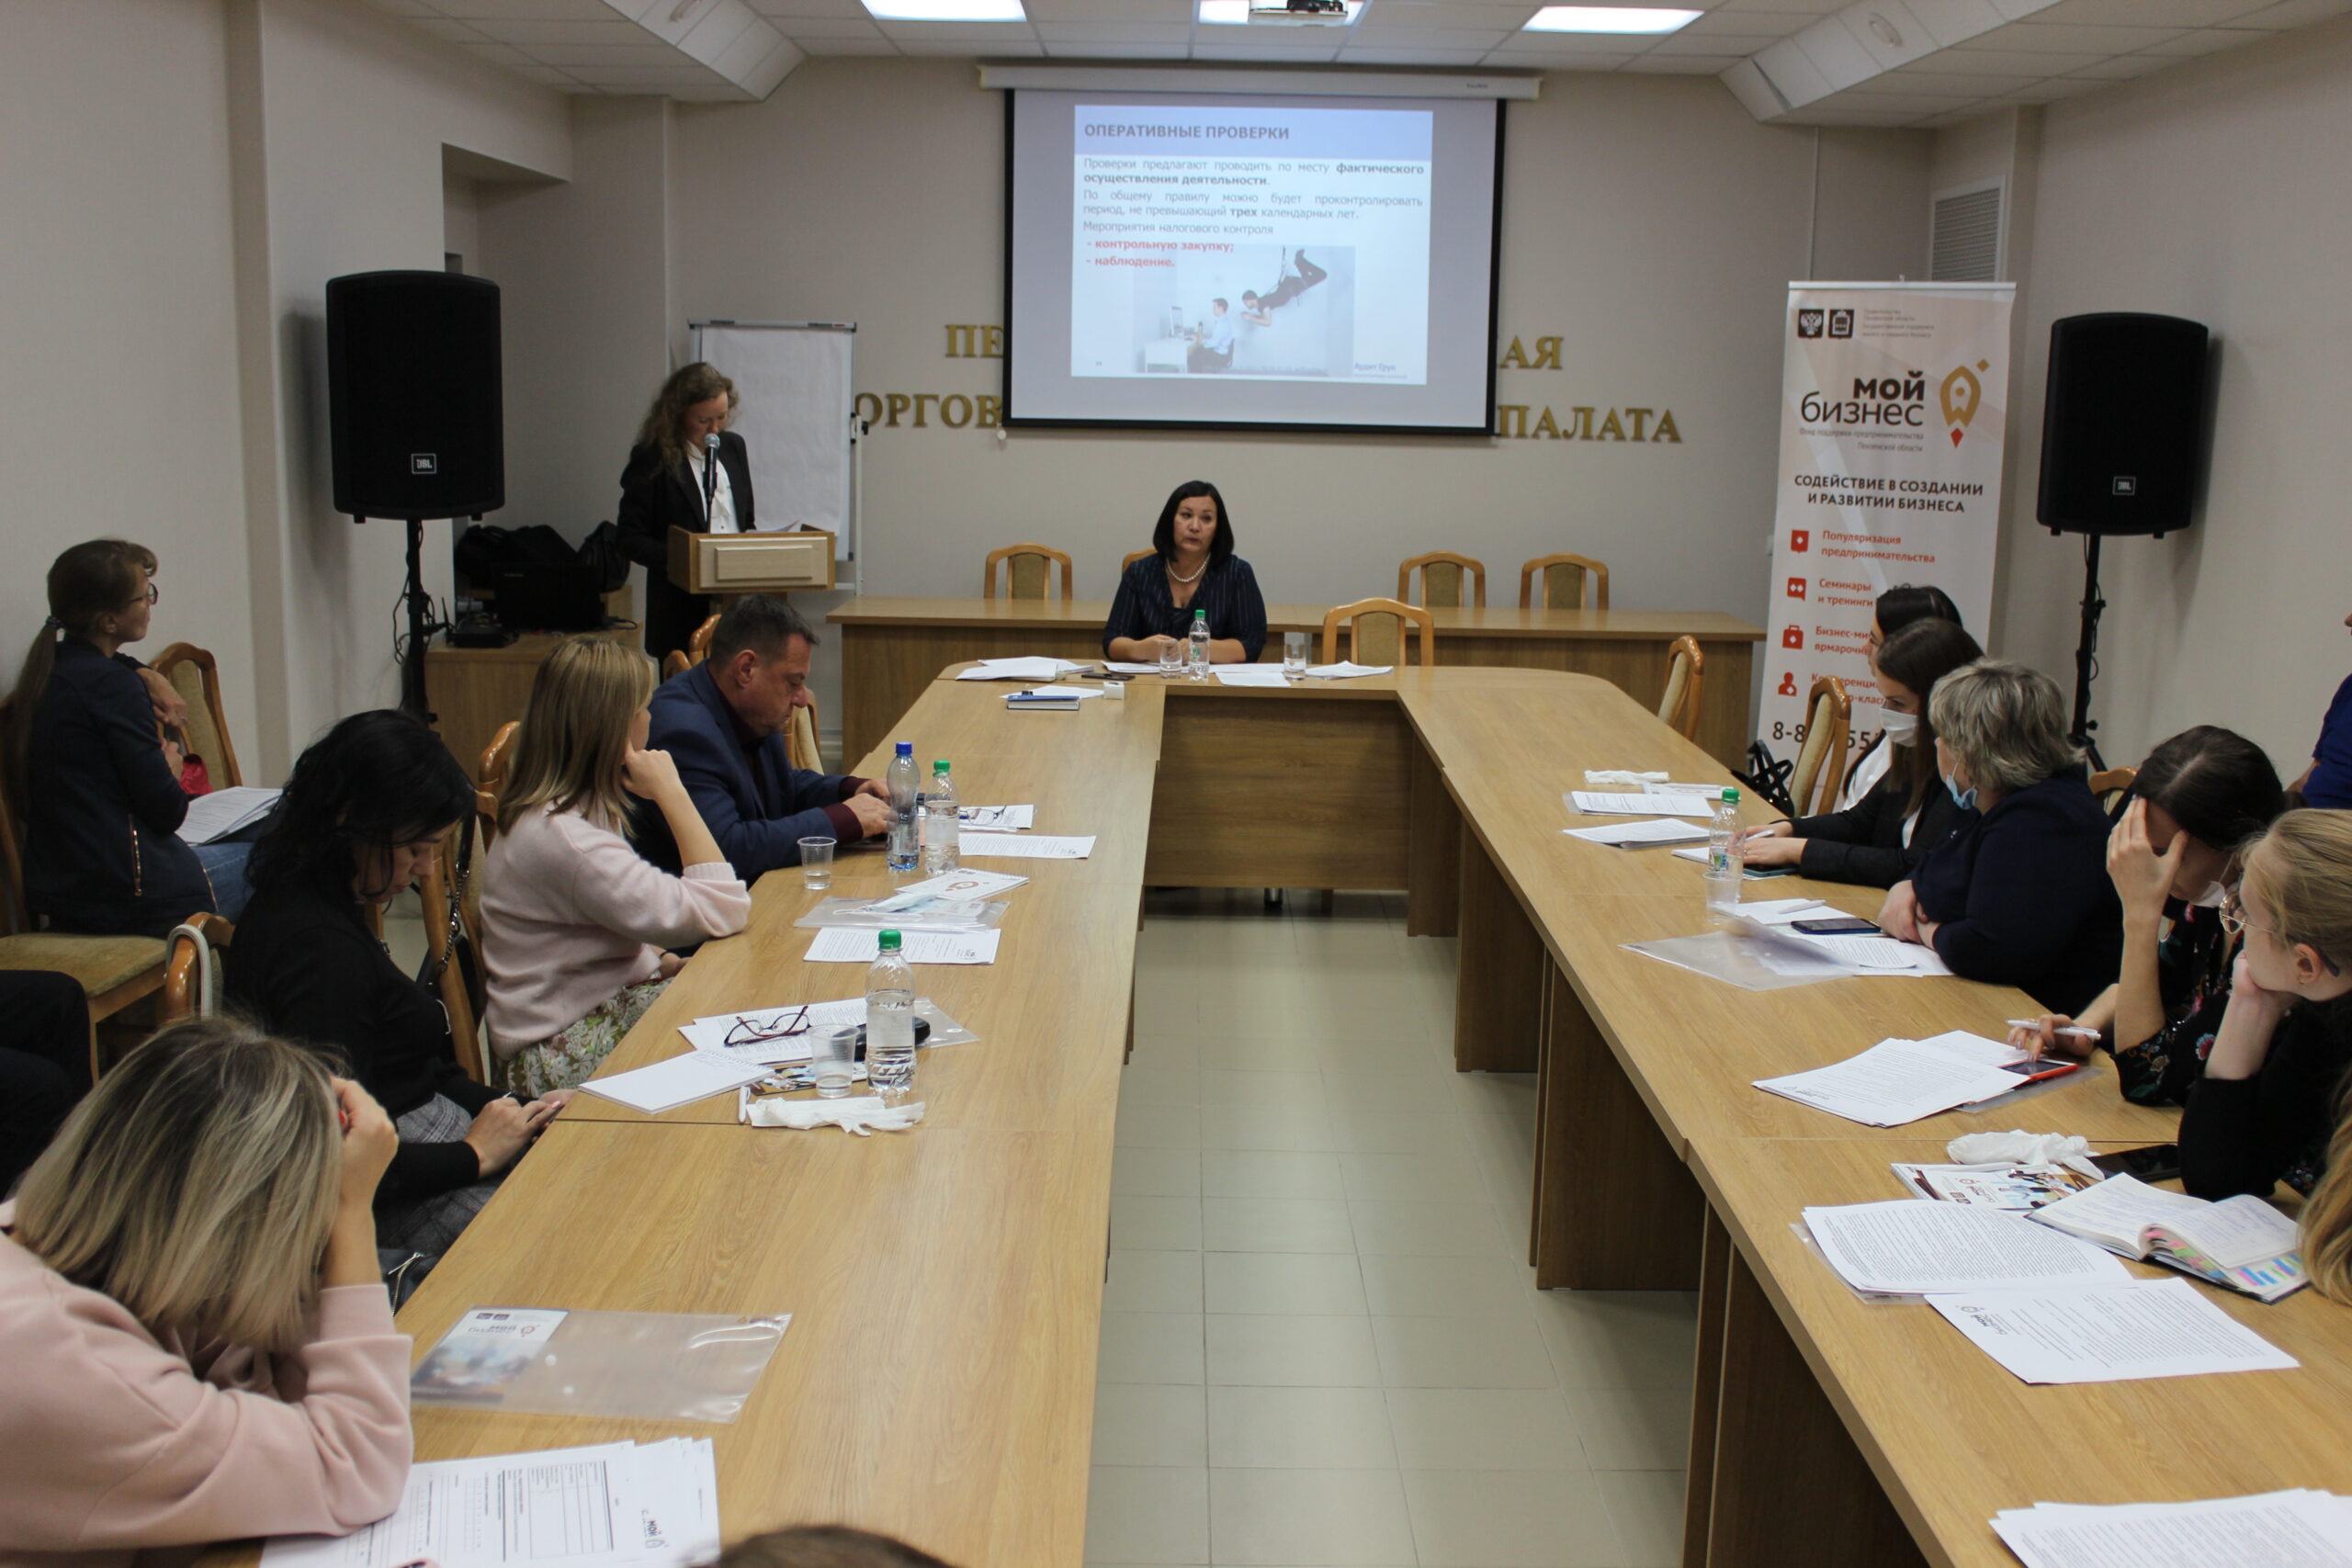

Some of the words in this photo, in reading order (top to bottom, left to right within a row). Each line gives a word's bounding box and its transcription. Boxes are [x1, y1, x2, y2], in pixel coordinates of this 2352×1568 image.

[1084, 124, 1201, 138] ОПЕРАТИВНЫЕ
[1205, 126, 1290, 140] ПРОВЕРКИ
[1084, 158, 1136, 171] Проверки
[1143, 160, 1207, 171] предлагают
[1214, 161, 1272, 173] проводить
[1278, 164, 1292, 172] по
[1298, 164, 1329, 174] месту
[1336, 163, 1424, 175] фактического
[1084, 175, 1179, 185] осуществления
[1182, 175, 1270, 186] деятельности.
[1083, 190, 1098, 200] По
[1111, 191, 1153, 203] общему
[1165, 193, 1211, 204] правилу
[1223, 194, 1258, 203] можно
[1271, 193, 1302, 205] будет
[1315, 196, 1423, 207] проконтролировать
[1083, 206, 1125, 216] период,
[1129, 206, 1142, 215] не
[1146, 206, 1227, 217] превышающий
[1230, 209, 1258, 219] трех
[1261, 209, 1334, 220] календарных
[1337, 210, 1360, 220] лет.
[1083, 221, 1156, 233] Мероприятия
[1159, 224, 1220, 234] налогового
[1224, 225, 1273, 235] контроля
[1095, 240, 1178, 252] контрольную
[1181, 242, 1235, 254] закупку;
[1094, 256, 1175, 267] наблюдение.
[944, 324, 1003, 358] ПЕ
[1498, 334, 1564, 370] АЯ
[1801, 391, 1924, 426] бизнес
[854, 392, 1002, 428] ОРГОВ
[1498, 405, 1682, 443] ПАЛАТА
[1794, 474, 1885, 491] СОДЕЙСТВИЕ
[1889, 479, 1896, 491] В
[1899, 479, 1984, 496] СОЗДАНИИ
[1808, 493, 1816, 504] И
[1820, 493, 1895, 509] РАЗВИТИИ
[1898, 498, 1964, 513] БИЗНЕСА
[1823, 530, 1902, 545] Популяризация
[1821, 548, 1936, 563] предпринимательства
[1819, 579, 1871, 592] Семинары
[1827, 597, 1873, 608] тренинги
